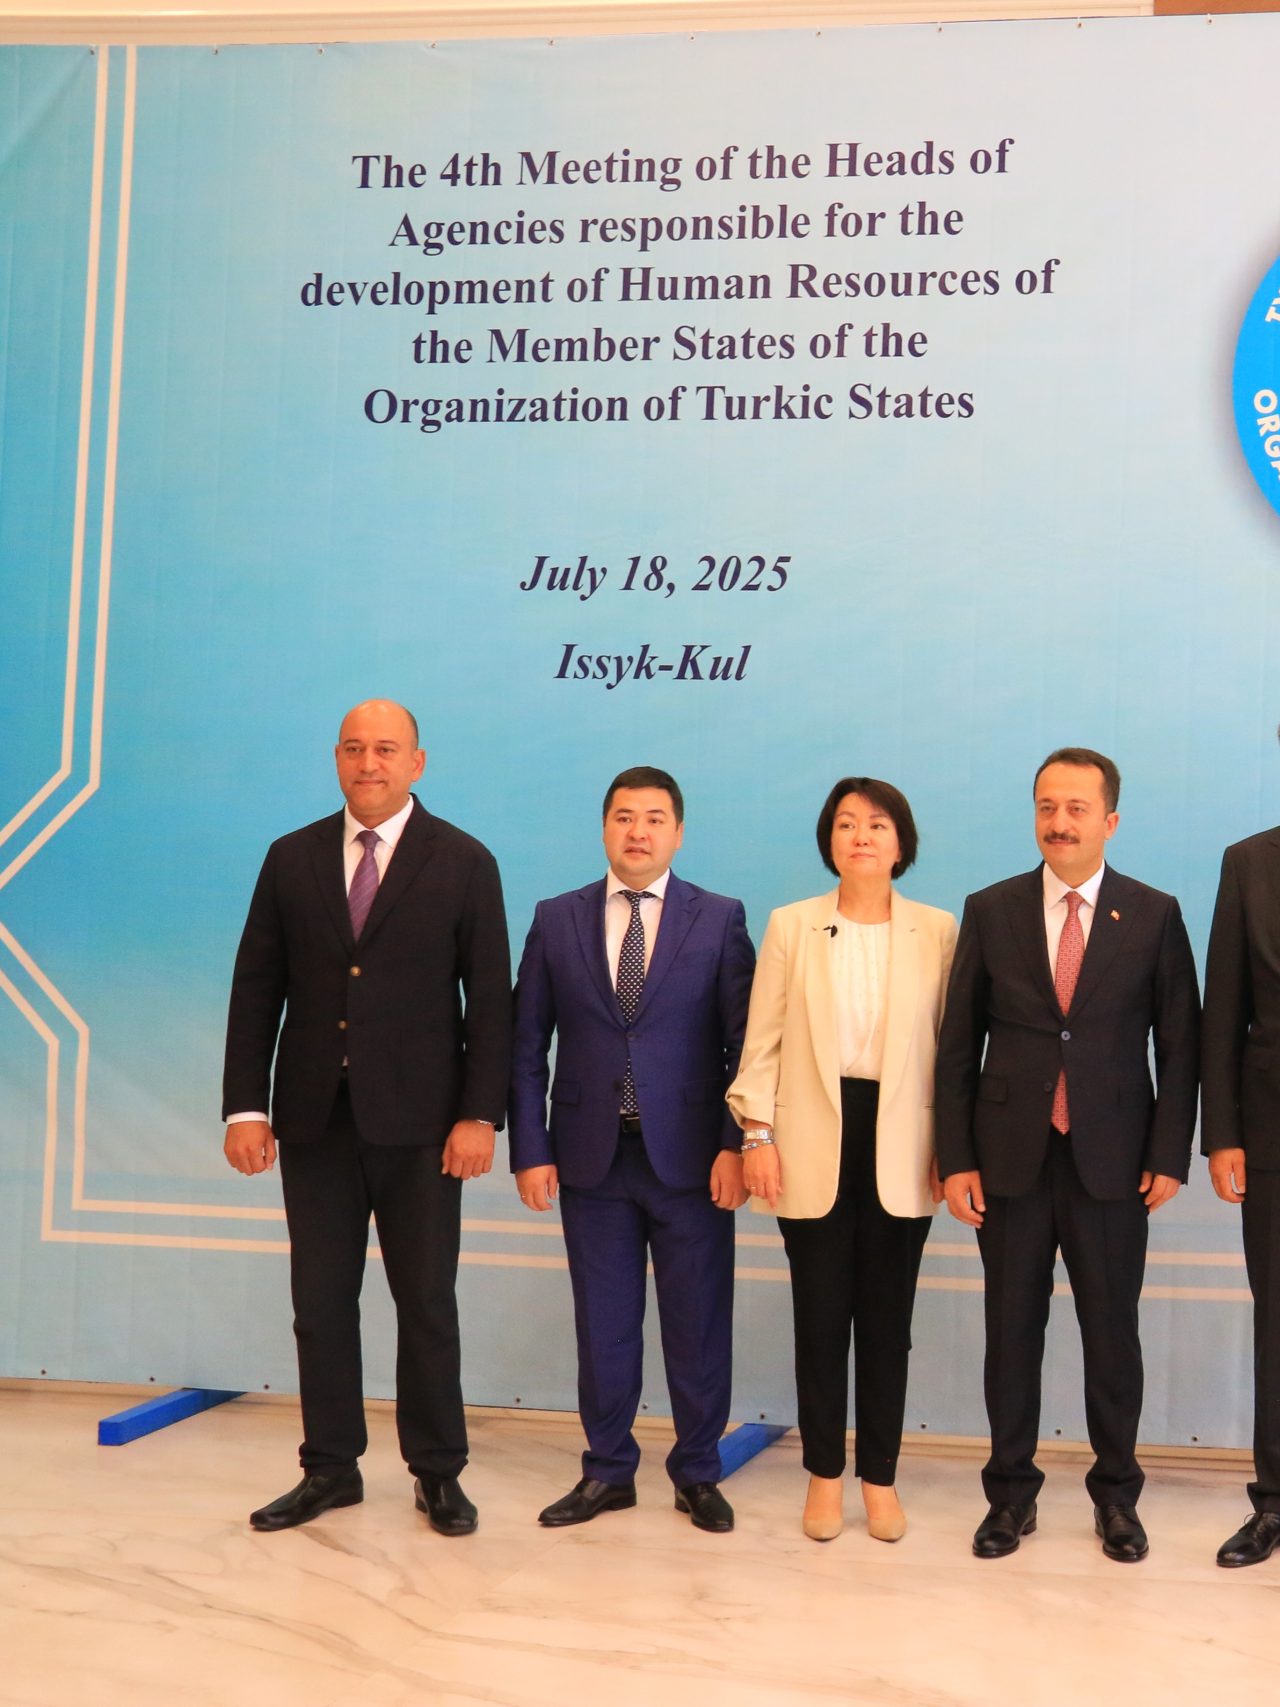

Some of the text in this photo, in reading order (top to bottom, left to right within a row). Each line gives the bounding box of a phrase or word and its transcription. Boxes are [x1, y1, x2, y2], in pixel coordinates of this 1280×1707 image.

[352, 137, 1015, 193] The 4th Meeting of the Heads of
[388, 200, 964, 256] Agencies responsible for the
[300, 258, 1061, 316] development of Human Resources of
[412, 322, 928, 364] the Member States of the
[363, 383, 974, 434] Organization of Turkic States
[520, 554, 792, 602] July 18, 2025
[553, 643, 752, 691] Issyk-Kul
